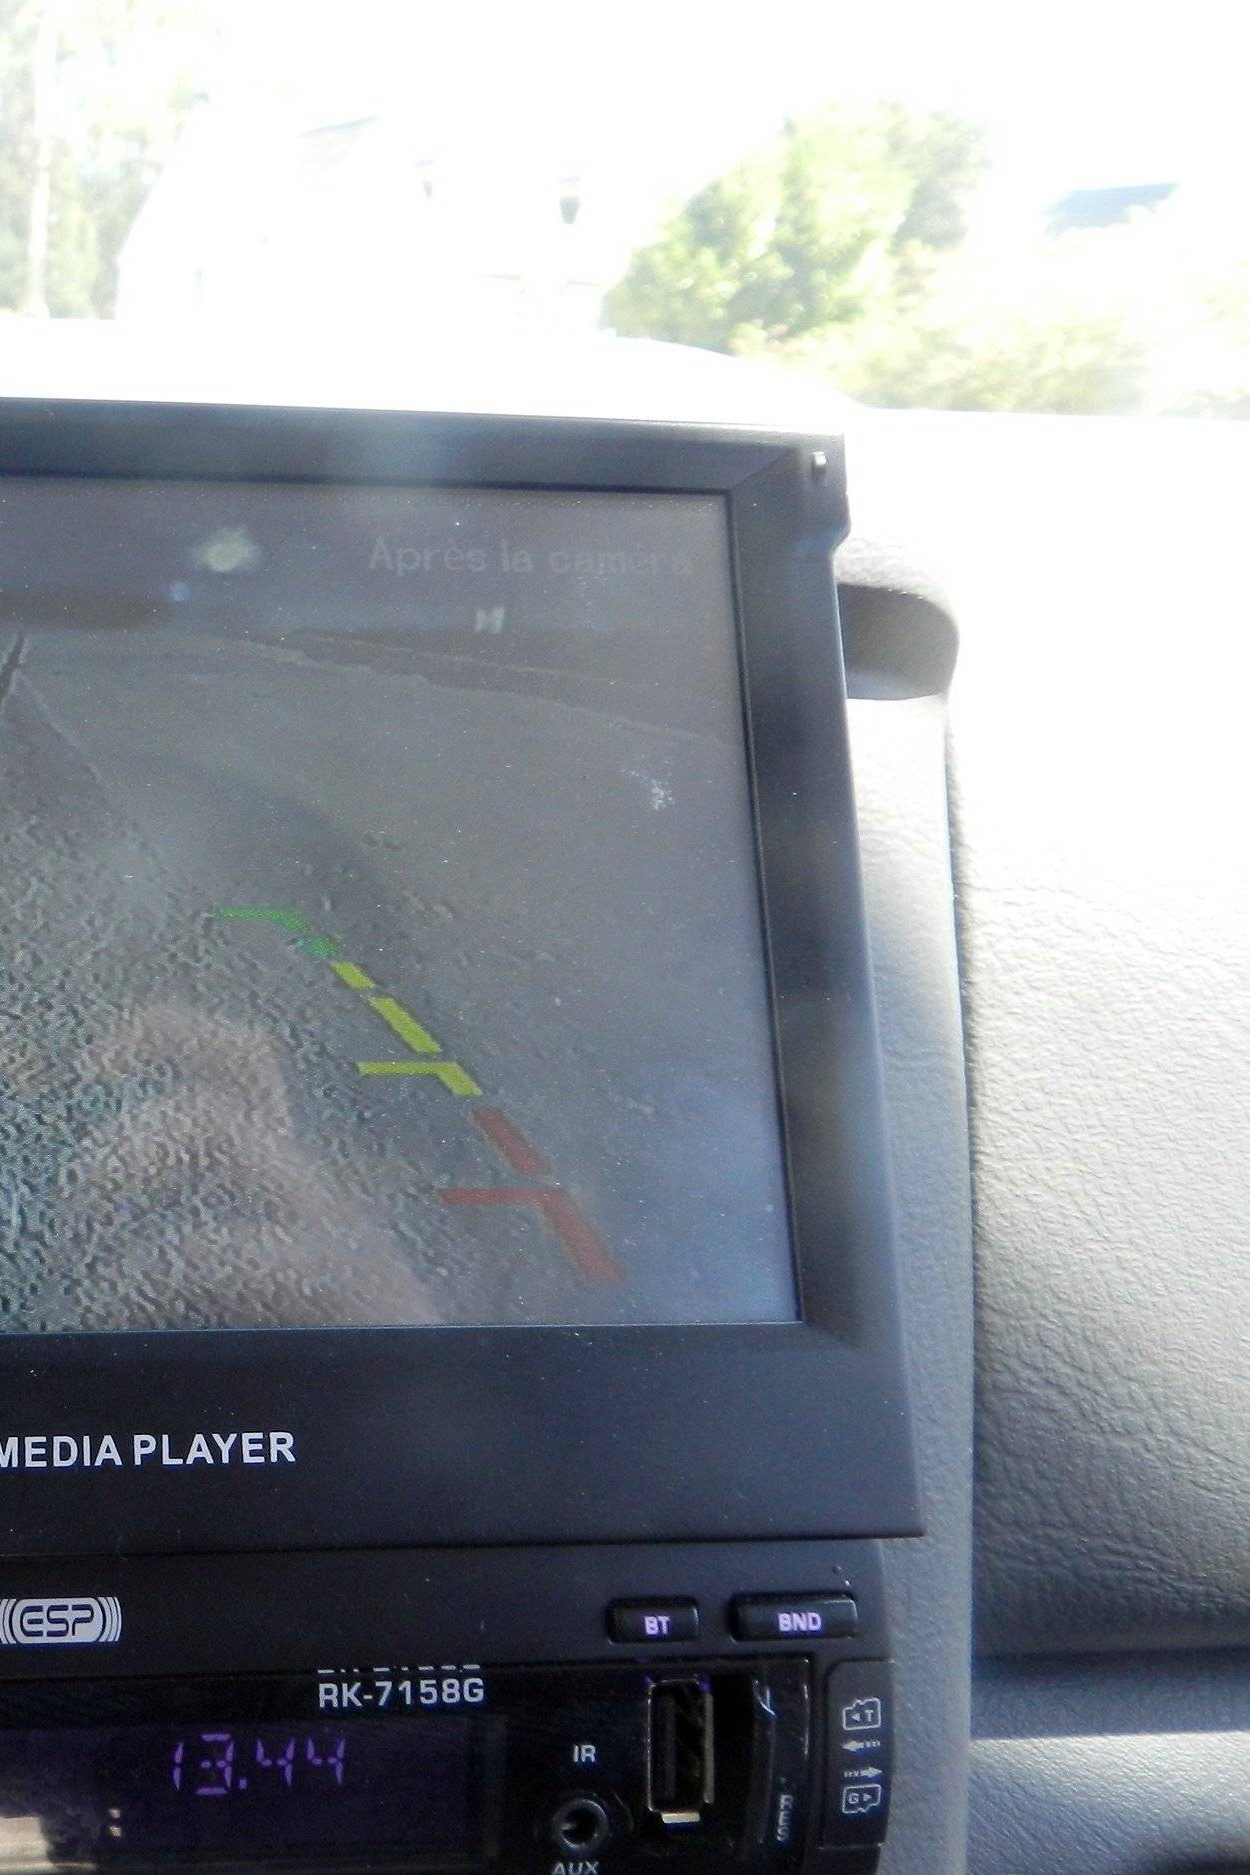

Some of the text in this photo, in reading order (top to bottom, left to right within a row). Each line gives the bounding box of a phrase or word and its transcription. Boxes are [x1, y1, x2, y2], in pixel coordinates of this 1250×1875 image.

[499, 538, 534, 574] la
[133, 1431, 297, 1468] PLAYER
[19, 1604, 96, 1637] ESP
[644, 1615, 670, 1635] BT
[778, 1612, 822, 1632] BND
[318, 1677, 485, 1708] RK-7158G
[573, 1744, 596, 1762] IR
[552, 1861, 599, 1875] AUX
